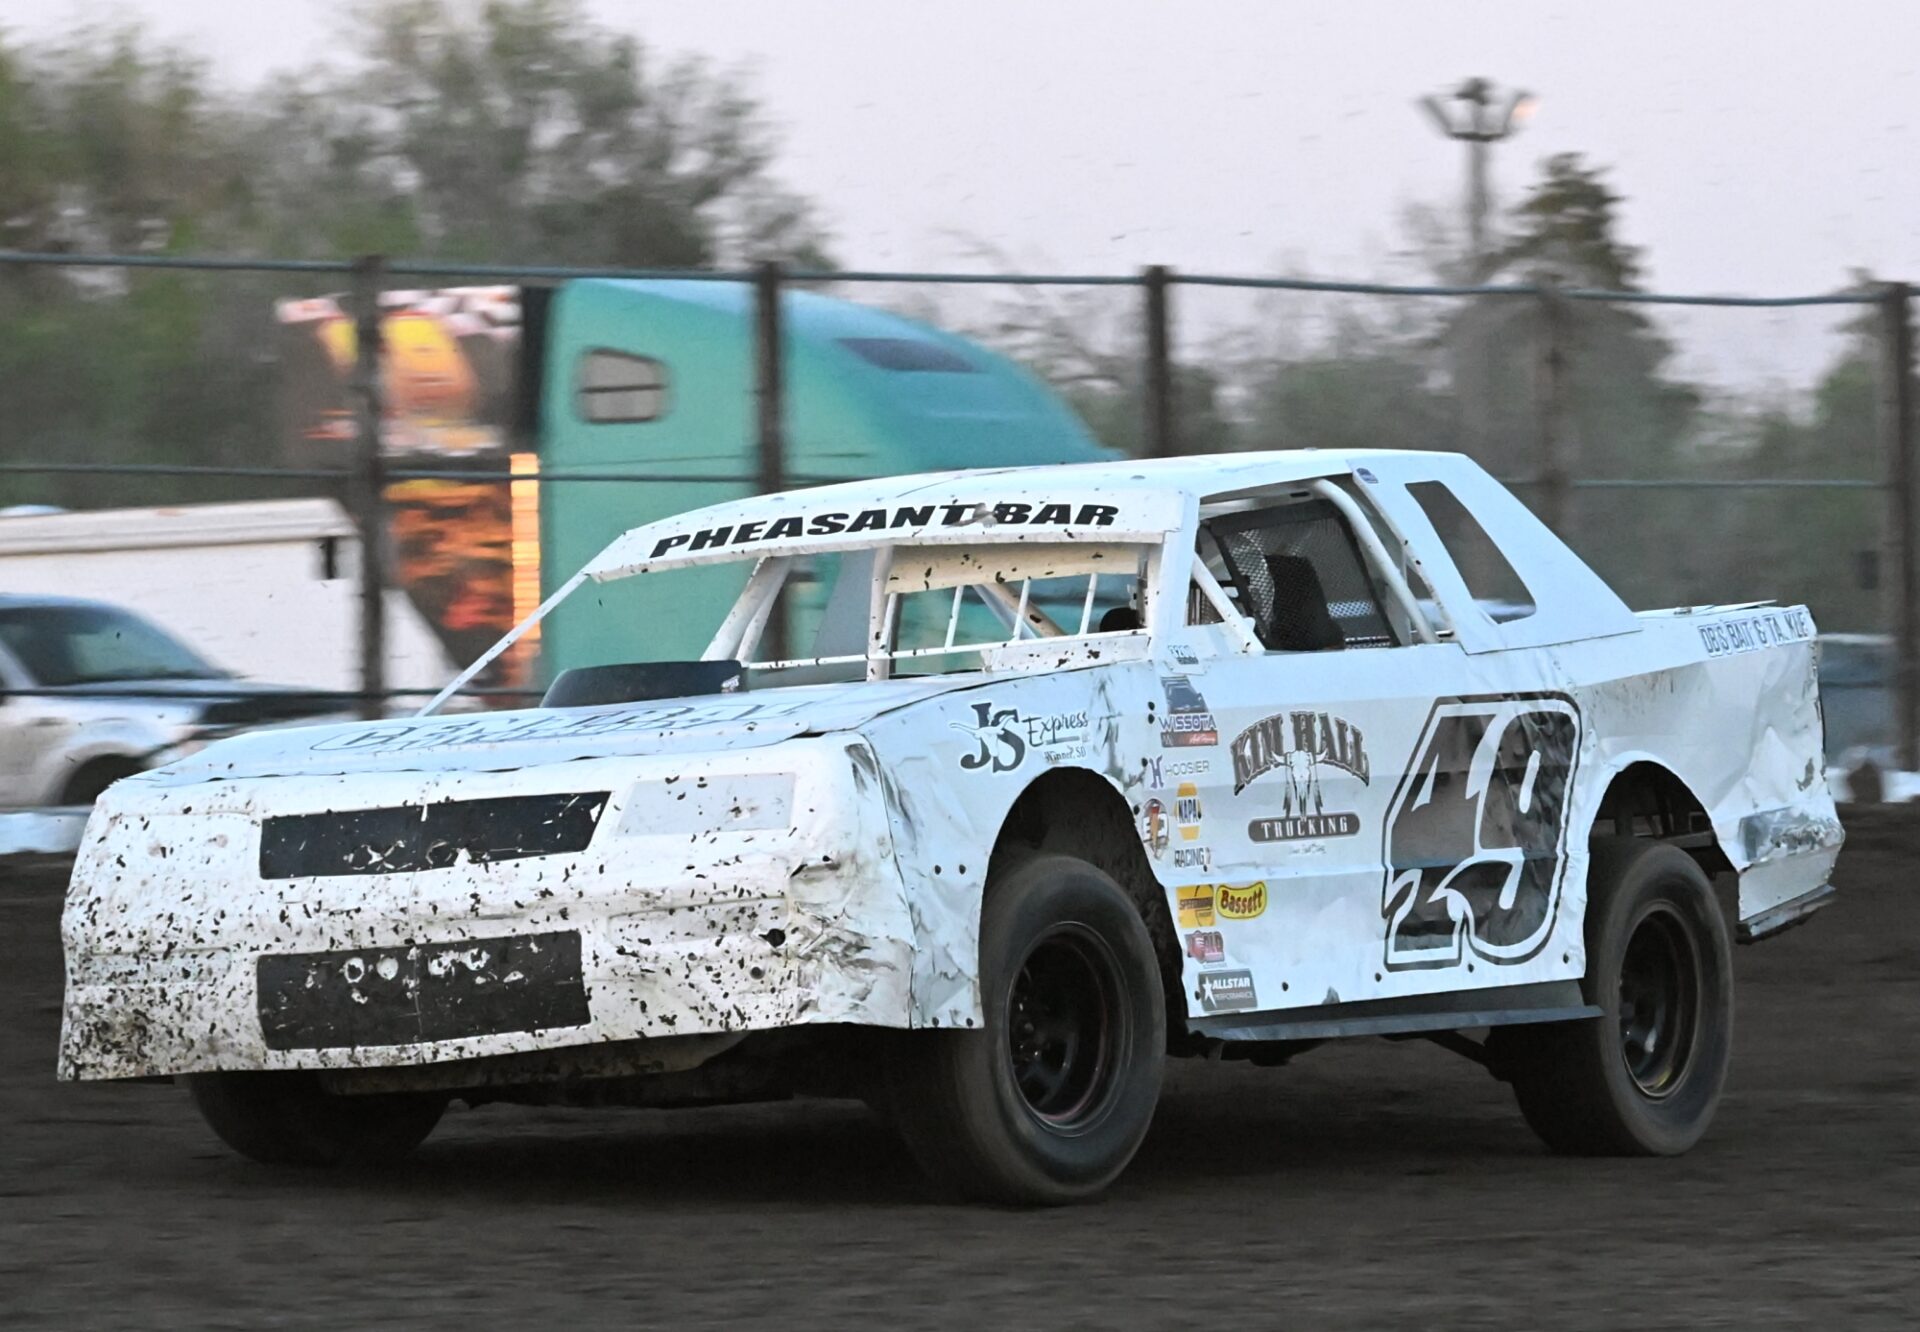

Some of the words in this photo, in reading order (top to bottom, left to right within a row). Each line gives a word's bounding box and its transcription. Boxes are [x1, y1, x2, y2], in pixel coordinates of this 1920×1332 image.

[648, 504, 971, 559] PHEASANT
[995, 503, 1120, 526] BAR
[1726, 620, 1756, 651] BAIT
[1753, 618, 1768, 645] &
[1022, 711, 1089, 747] Express
[1159, 713, 1216, 731] WISSOTA
[1165, 760, 1210, 776] HOOSIER
[1177, 799, 1200, 825] NAPA
[1261, 815, 1349, 840] TRUCKING
[1174, 848, 1204, 868] RACING
[1220, 887, 1263, 914] Bassett
[1212, 976, 1251, 990] ALLSTAR
